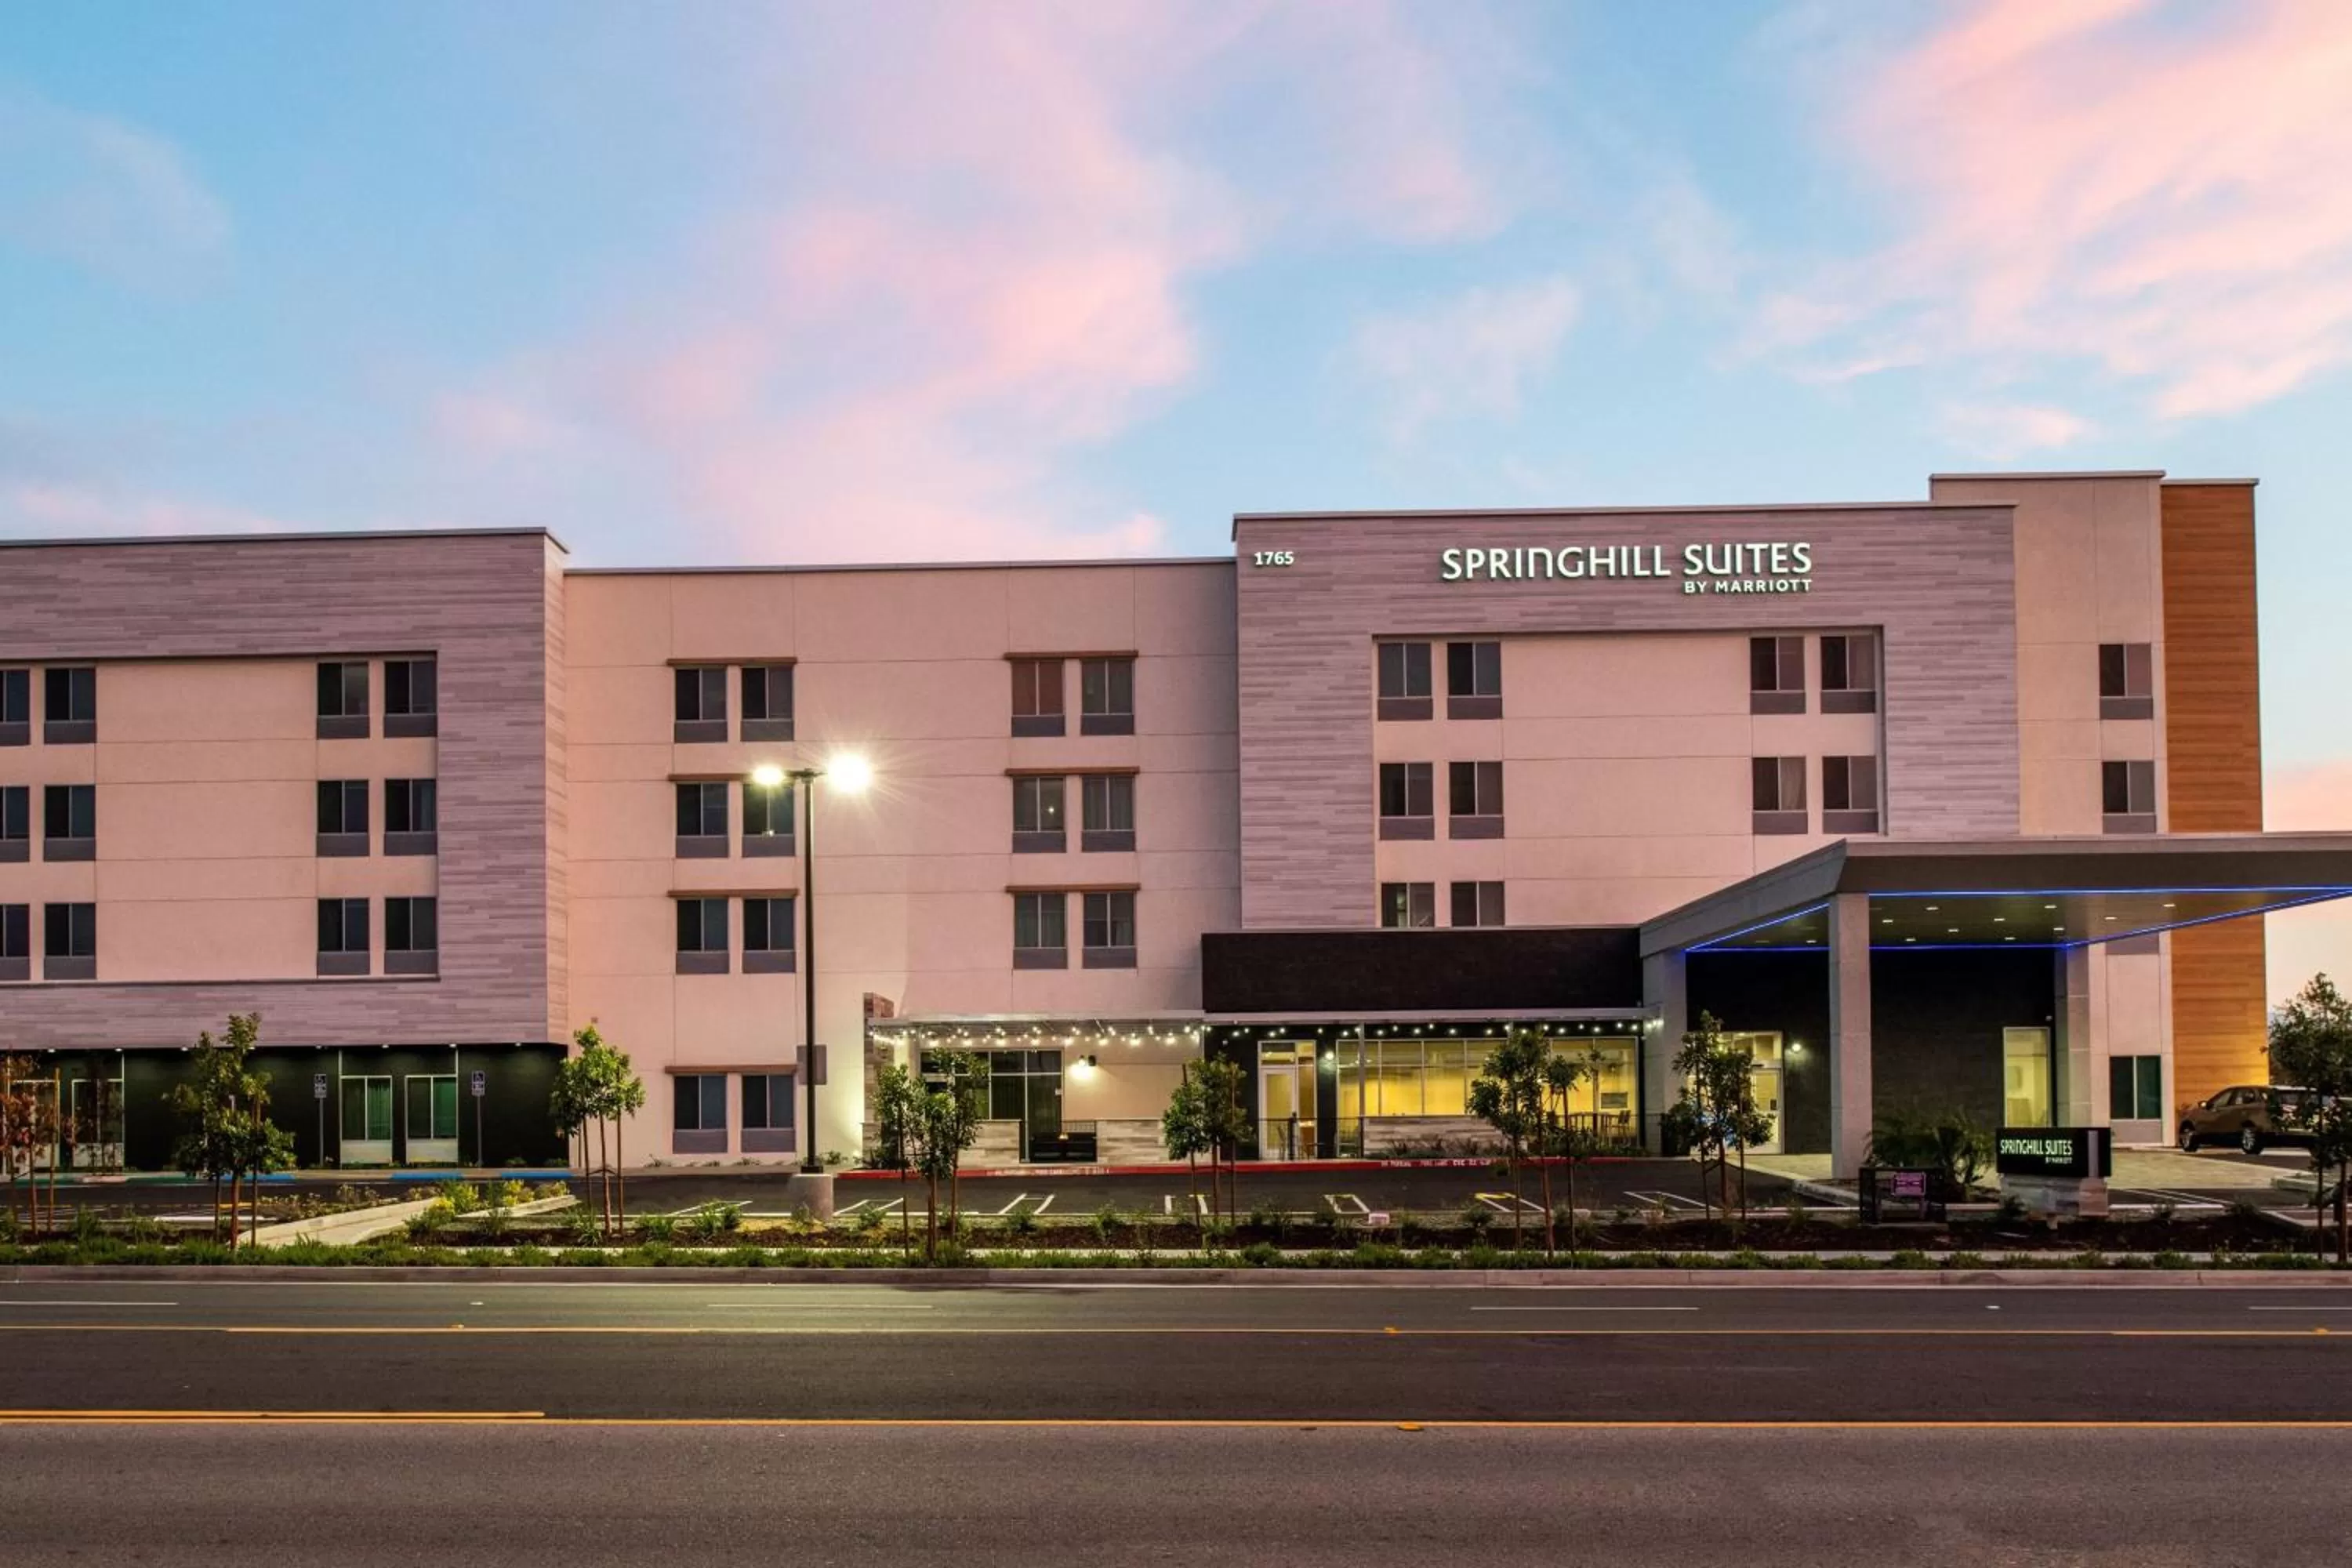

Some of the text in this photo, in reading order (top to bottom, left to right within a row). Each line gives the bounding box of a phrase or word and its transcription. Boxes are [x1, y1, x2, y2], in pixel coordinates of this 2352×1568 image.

[1254, 550, 1294, 565] 1765
[1442, 542, 1813, 579] SPRINGHILL SUITES
[1684, 579, 1813, 593] BY MARRIOTT
[2000, 1139, 2073, 1156] SPRINGHILL SUITES
